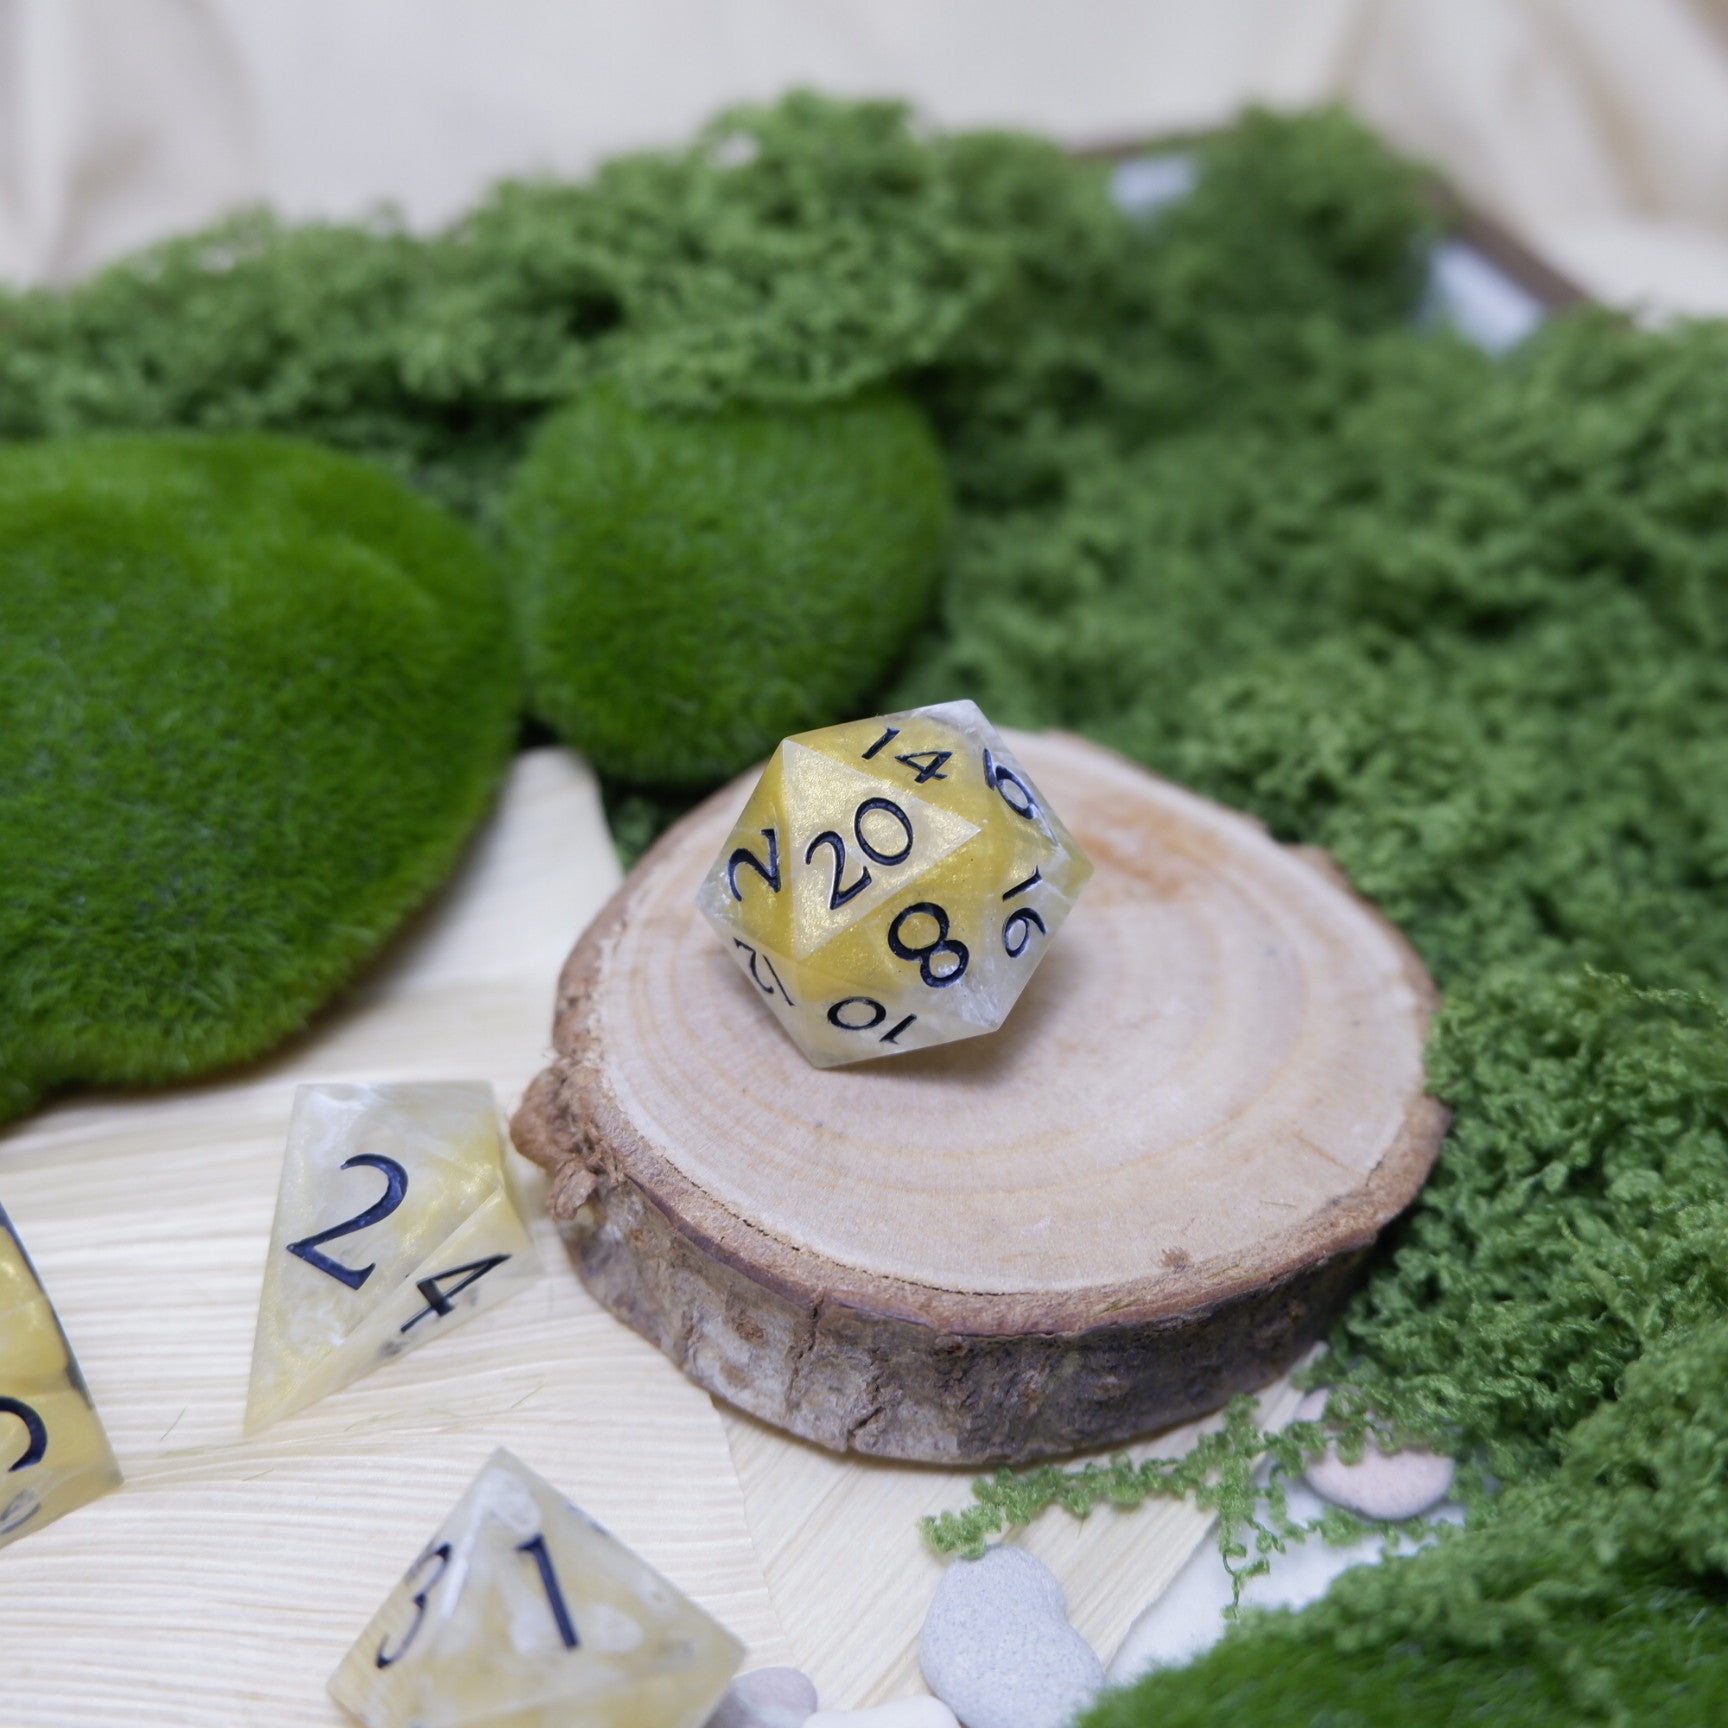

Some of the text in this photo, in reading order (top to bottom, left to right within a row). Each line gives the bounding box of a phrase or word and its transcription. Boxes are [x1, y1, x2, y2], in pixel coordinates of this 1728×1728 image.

[861, 726, 953, 784] 14
[728, 828, 782, 902] 2
[804, 796, 914, 910] 20
[887, 902, 970, 988] 8
[1002, 865, 1047, 958] 16
[827, 996, 917, 1044] 10
[286, 1153, 410, 1291] 2
[401, 1253, 513, 1334] 4
[375, 1541, 453, 1670] 3
[515, 1532, 582, 1651] 1
